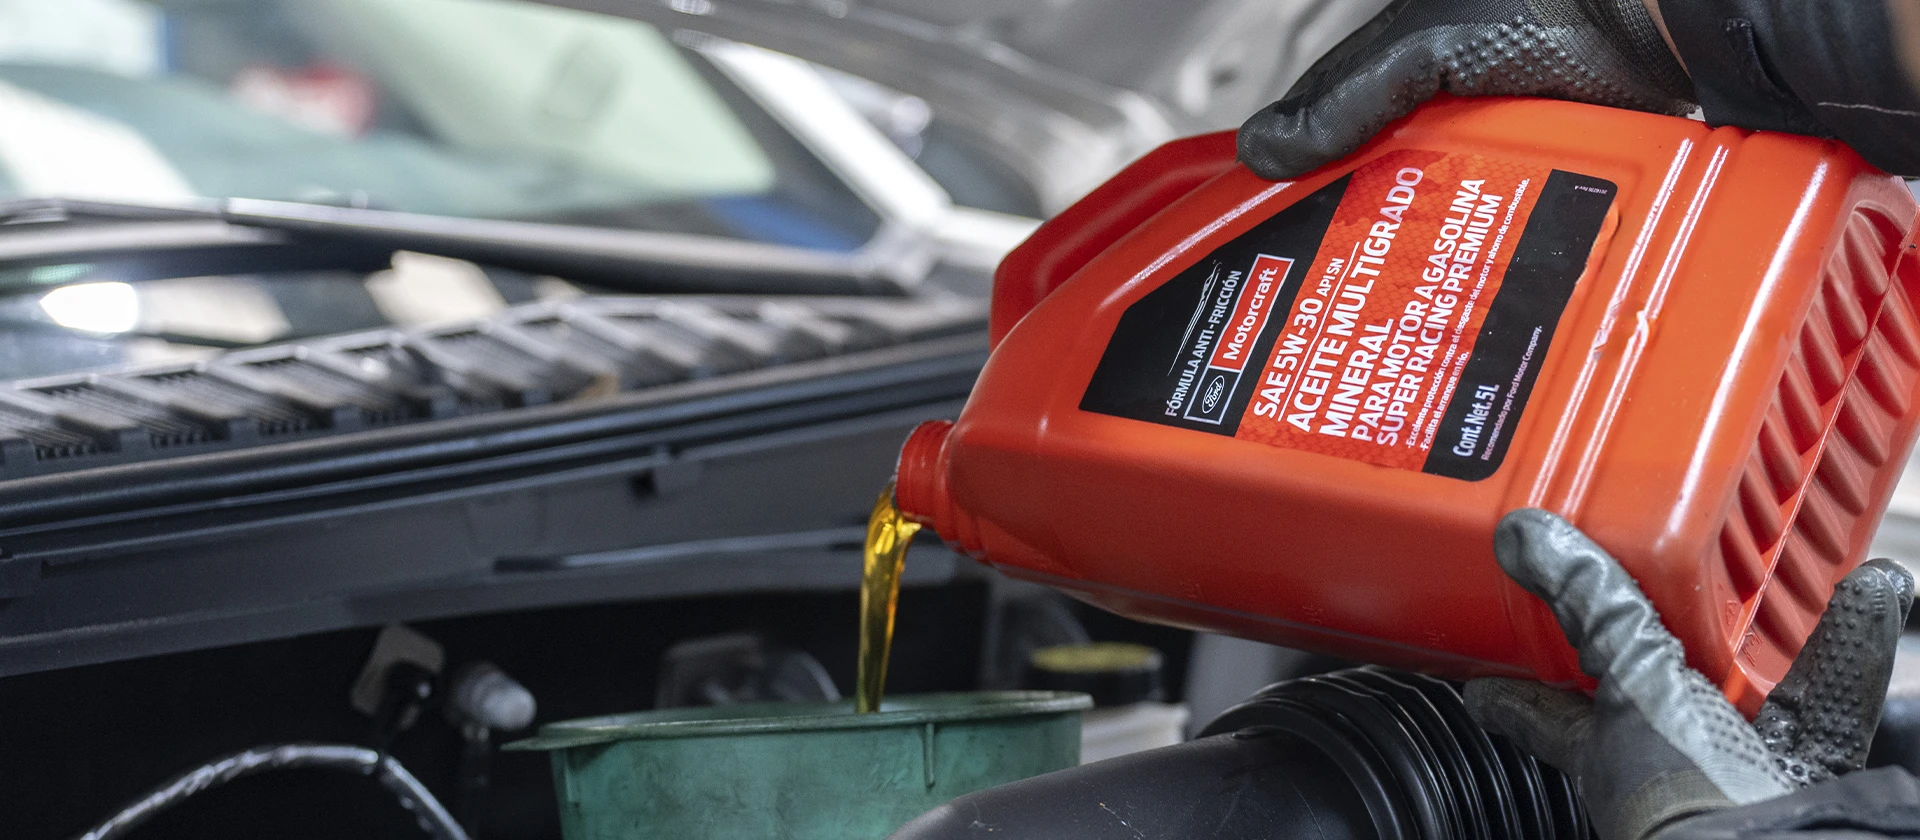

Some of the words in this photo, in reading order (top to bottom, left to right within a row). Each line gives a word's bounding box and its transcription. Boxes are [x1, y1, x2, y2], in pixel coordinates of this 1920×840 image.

[1422, 180, 1486, 282] GASOLINA
[1498, 224, 1509, 235] de
[1488, 234, 1504, 260] ahorro
[1414, 285, 1438, 300] A
[1476, 265, 1491, 291] motor
[1286, 338, 1348, 432] ACEITE
[1326, 167, 1424, 337] MULTIGRADO
[1469, 290, 1480, 300] del
[1376, 373, 1424, 447] SUPER
[1405, 294, 1458, 372] RACING
[1442, 194, 1503, 293] PREMIUM
[1454, 300, 1475, 335] desgaste
[1205, 382, 1222, 407] Ford
[1222, 267, 1278, 361] Motorcraft
[1253, 372, 1292, 419] SAE
[1273, 298, 1323, 371] 5W-30
[1316, 275, 1336, 297] API
[1326, 258, 1345, 275] SN
[1377, 300, 1430, 378] MOTOR
[1452, 335, 1461, 343] el
[1522, 325, 1543, 361] Company.
[1441, 343, 1458, 368] contra
[1319, 319, 1394, 437] MINERAL
[1452, 365, 1461, 377] en
[1513, 359, 1529, 383] Motor
[1165, 359, 1201, 417] FÓRMULA
[1437, 376, 1457, 411] arranque
[1475, 384, 1500, 402] 5L
[1507, 381, 1519, 399] Ford
[1351, 382, 1396, 442] PARA
[1434, 409, 1442, 419] el
[1464, 401, 1492, 426] Net.
[1503, 399, 1514, 412] por
[1453, 425, 1482, 457] Cont.
[1481, 411, 1508, 461] Recomendado
